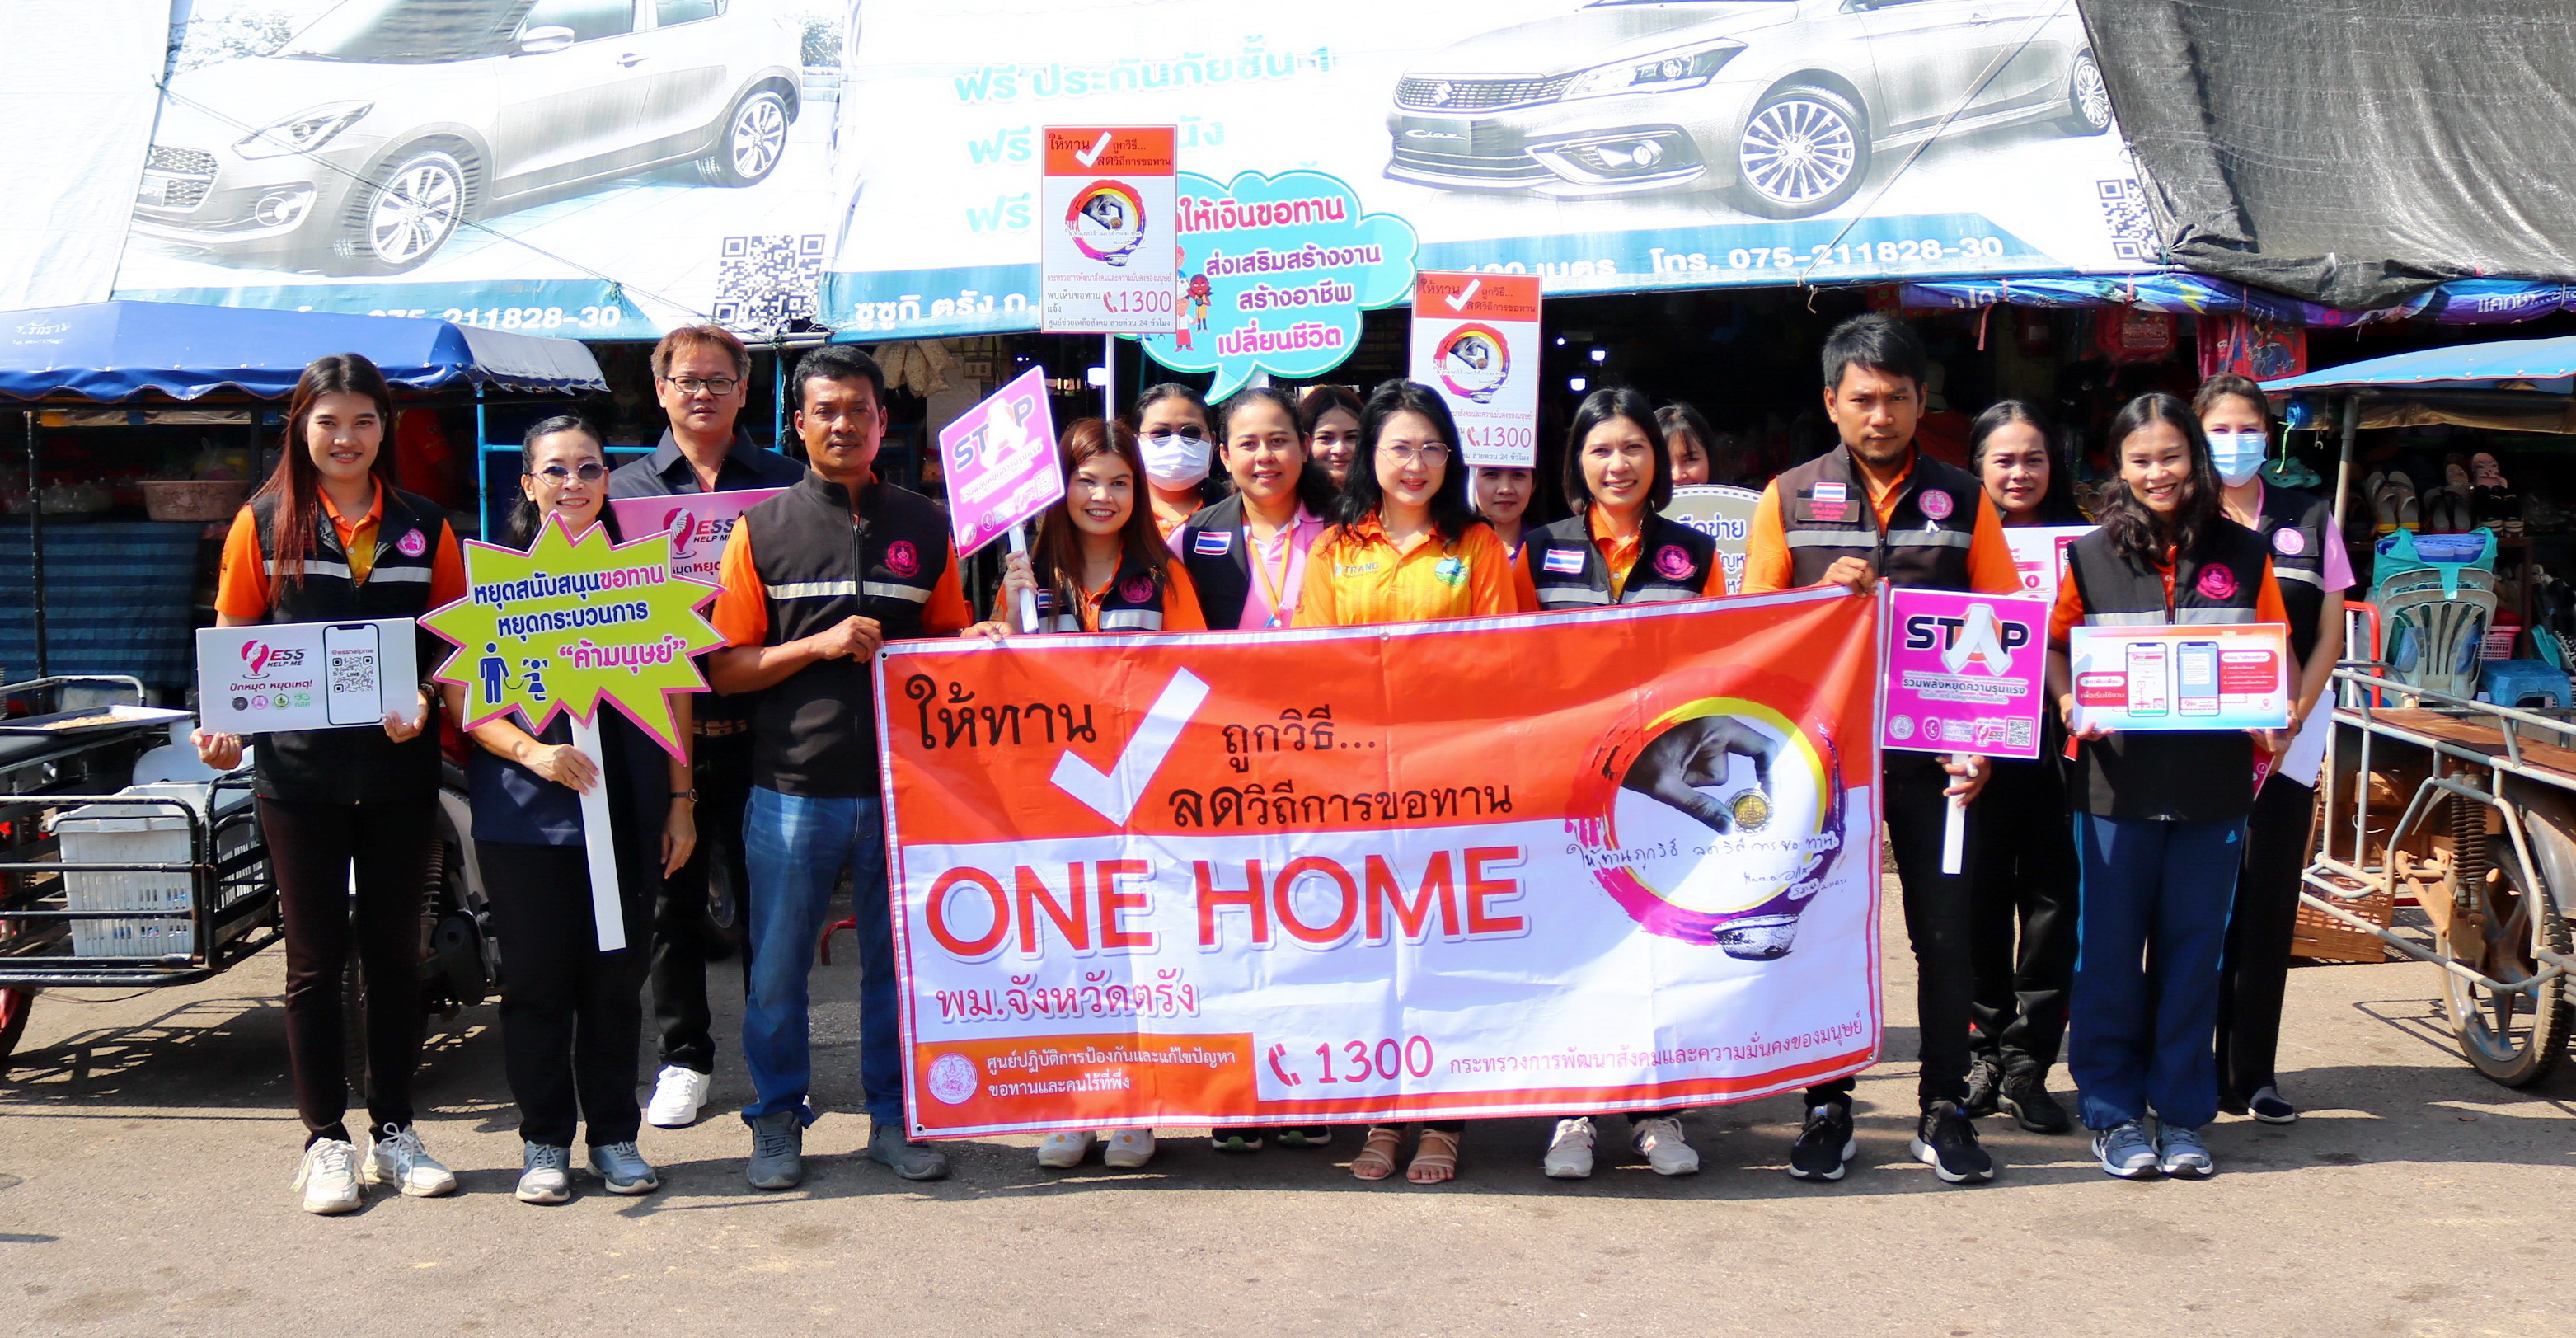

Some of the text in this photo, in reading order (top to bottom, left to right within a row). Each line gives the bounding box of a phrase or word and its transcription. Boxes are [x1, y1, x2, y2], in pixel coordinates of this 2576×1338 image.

[955, 64, 1018, 101] ฟรี
[1033, 34, 1294, 96] ประกันภัยชั้น
[968, 126, 1032, 165] ฟรี
[1049, 133, 1091, 151] ให้ทาน
[1113, 139, 1147, 153] ถูกวิธี...
[1405, 129, 1467, 140] Ciaz
[965, 192, 1031, 232] ฟรี
[1206, 244, 1381, 276] ส่งเสริมสร้างงาน
[1649, 248, 1719, 275] โทร.
[1728, 236, 2005, 270] 075-211828-30
[1047, 288, 1101, 300] พบเห็นขอทาน
[1119, 290, 1172, 312] 1300
[1239, 280, 1352, 310] สร้างอาชีพ
[1420, 278, 1460, 295] ให้ทาน
[854, 294, 922, 331] ซูซูกิ
[931, 289, 994, 318] ตรัง
[1047, 303, 1062, 313] แจ้ง
[1048, 318, 1108, 328] ศูนย์ช่วยเหลือสังคม
[1110, 318, 1137, 326] สายด่วน
[1151, 317, 1171, 326] ชั่วโมง
[1218, 320, 1341, 354] เปลี่ยนชีวิต
[954, 396, 1033, 470] STP
[1482, 426, 1532, 448] 1300
[1510, 453, 1530, 461] ชั่วโมง
[693, 534, 717, 542] HELP
[696, 519, 736, 534] ESS
[1344, 561, 1379, 575] TRANG
[474, 566, 665, 610] หยุดสนับสนุนขอทาน
[498, 602, 648, 641] หยุดกระบวนการ
[1907, 615, 2029, 657] STP
[270, 649, 307, 661] ESS
[270, 679, 312, 691] หยุดเหตุ!
[1903, 678, 2025, 696] รวมพลังหยุดความรุนแรง
[905, 673, 1097, 750] ให้ทาน
[1222, 704, 1376, 773] ถูกวิธี...
[1168, 779, 1513, 828] ลดวิถีการขอทาน
[926, 845, 1524, 956] ONE HOME
[936, 968, 1198, 1020] พม.จังหวัดตรัง
[1450, 1010, 1863, 1075] กระทรวงการพัฒนาสังคมและความมั่นคงของมนุษย์
[987, 1046, 1236, 1076] ศูนย์ปฏิบัติการป้องกันและแก้ไขปัญหา
[1315, 1035, 1433, 1083] 1300
[988, 1068, 1130, 1097] ขอทานและคนไร้ที่พึ่ง
